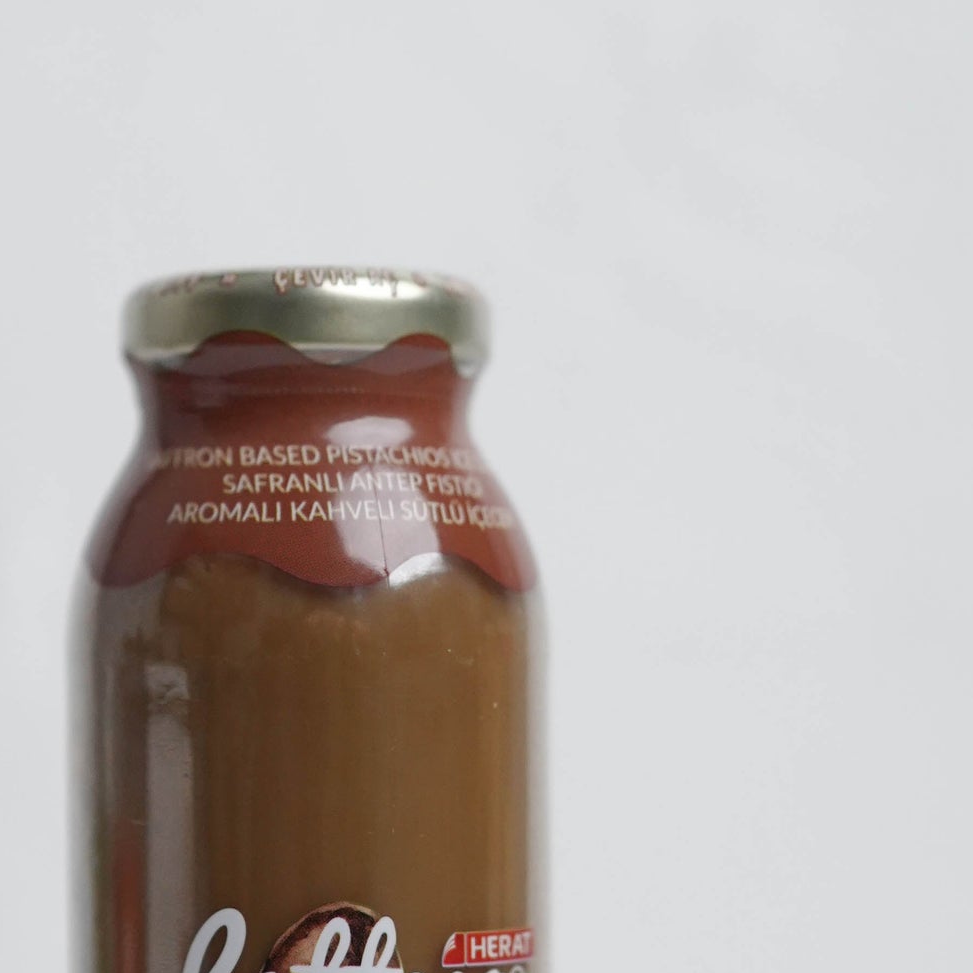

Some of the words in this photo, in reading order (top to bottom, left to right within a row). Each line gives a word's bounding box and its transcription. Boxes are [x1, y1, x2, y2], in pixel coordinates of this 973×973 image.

[239, 444, 321, 467] BASED
[326, 443, 451, 470] PISTACHIOS
[222, 471, 344, 495] SAFRANLI
[350, 471, 423, 493] ANTEP
[166, 500, 283, 526] AROMALI
[290, 499, 395, 523] KAHVELI
[400, 497, 466, 527] SÜTLÜ
[470, 931, 532, 960] HERAT
